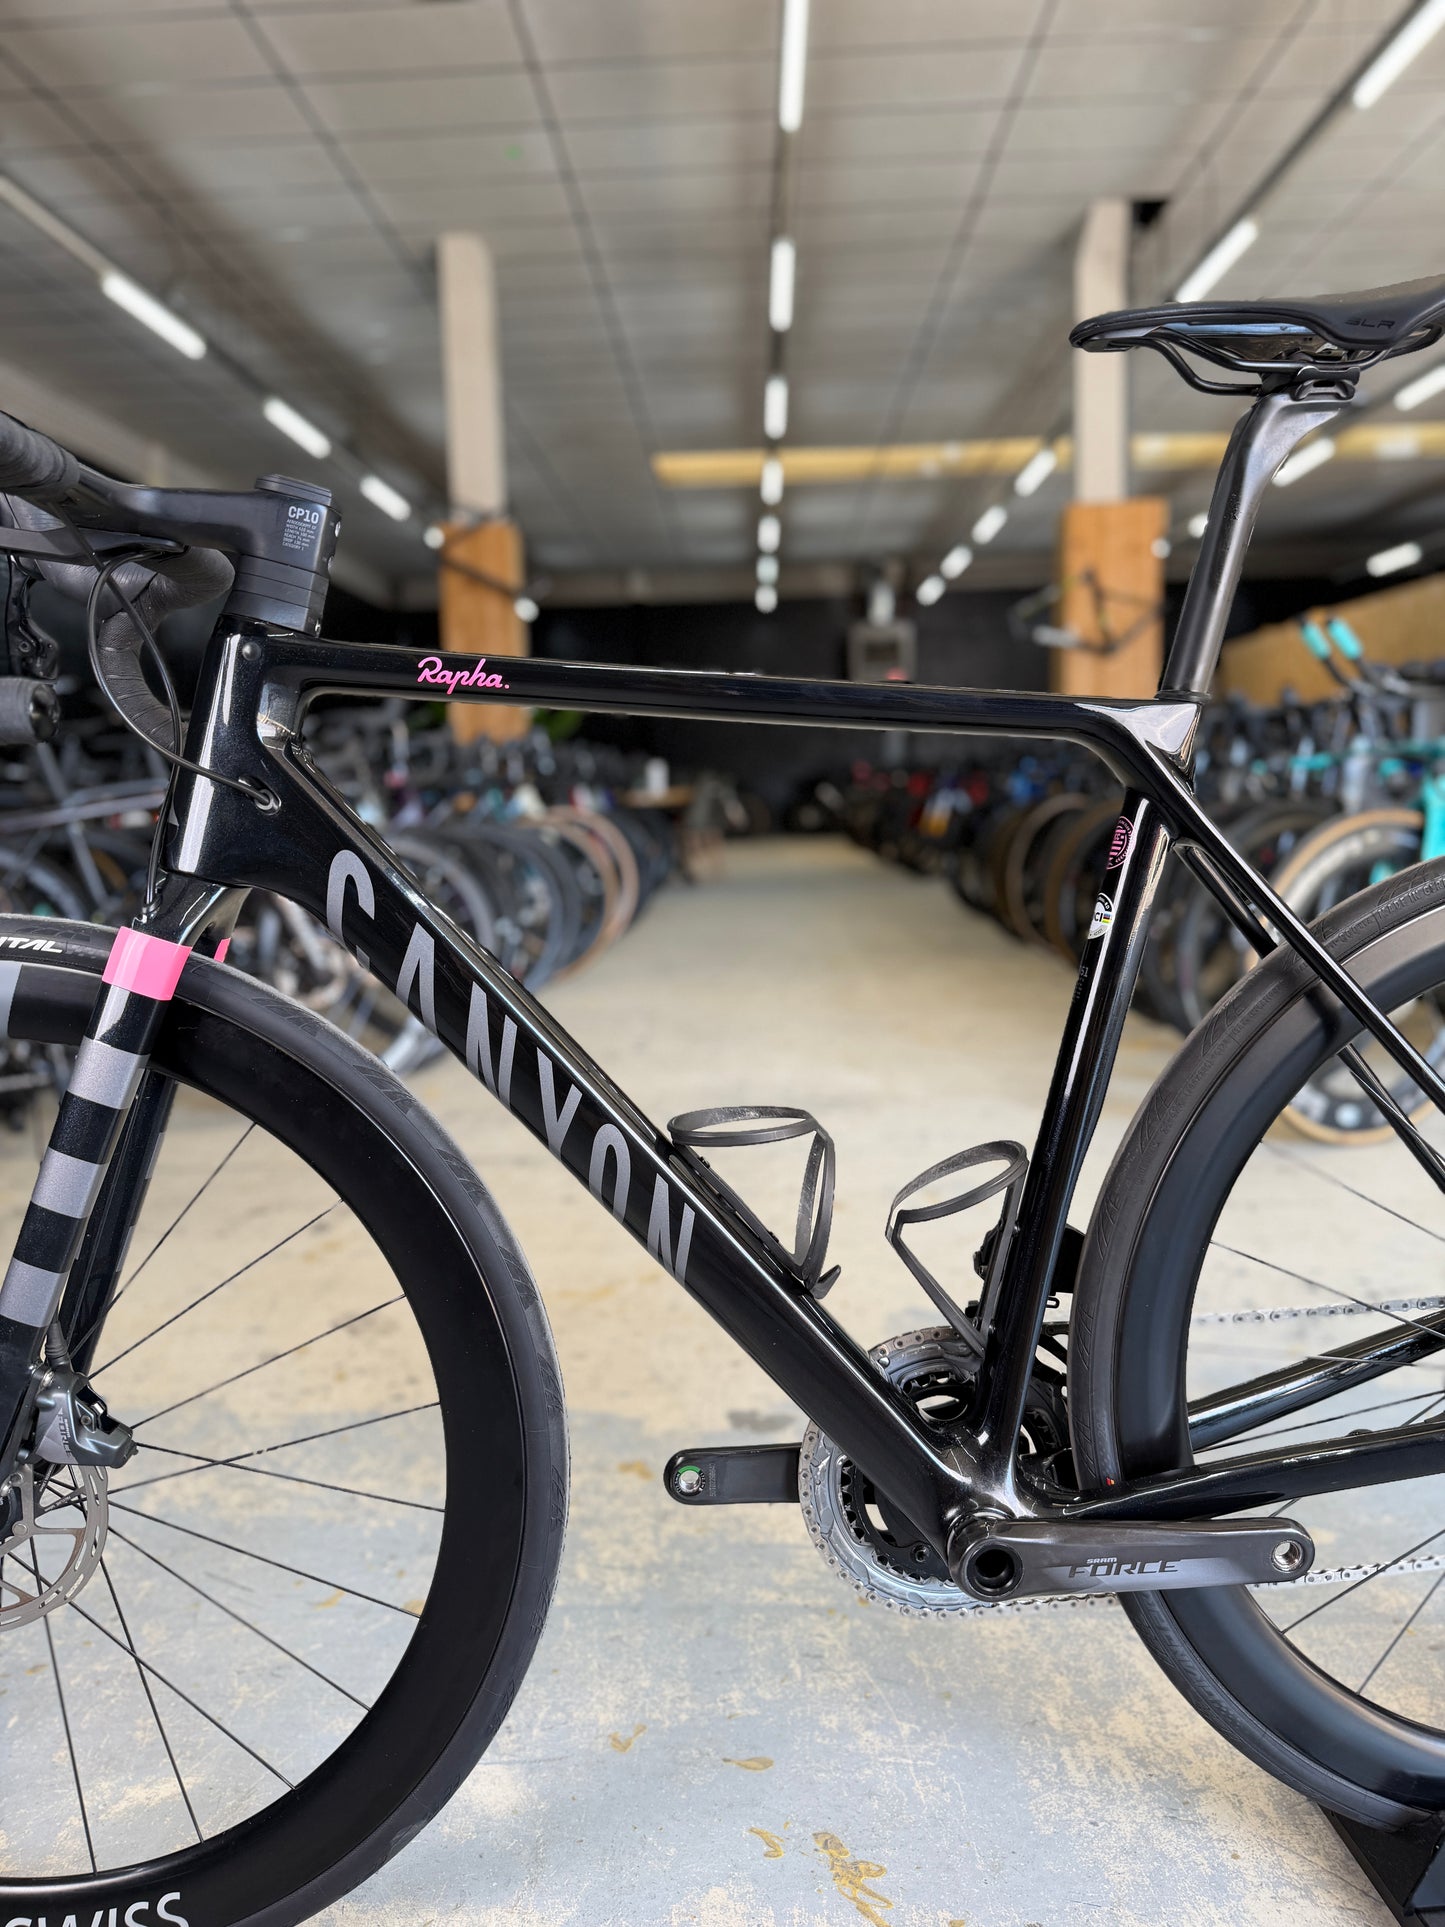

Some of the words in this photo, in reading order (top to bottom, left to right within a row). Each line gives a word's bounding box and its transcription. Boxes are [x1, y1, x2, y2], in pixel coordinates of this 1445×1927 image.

[1344, 317, 1396, 329] SLR
[288, 506, 319, 524] CP10
[326, 849, 696, 1291] CANYON
[1068, 1560, 1179, 1579] FORCE
